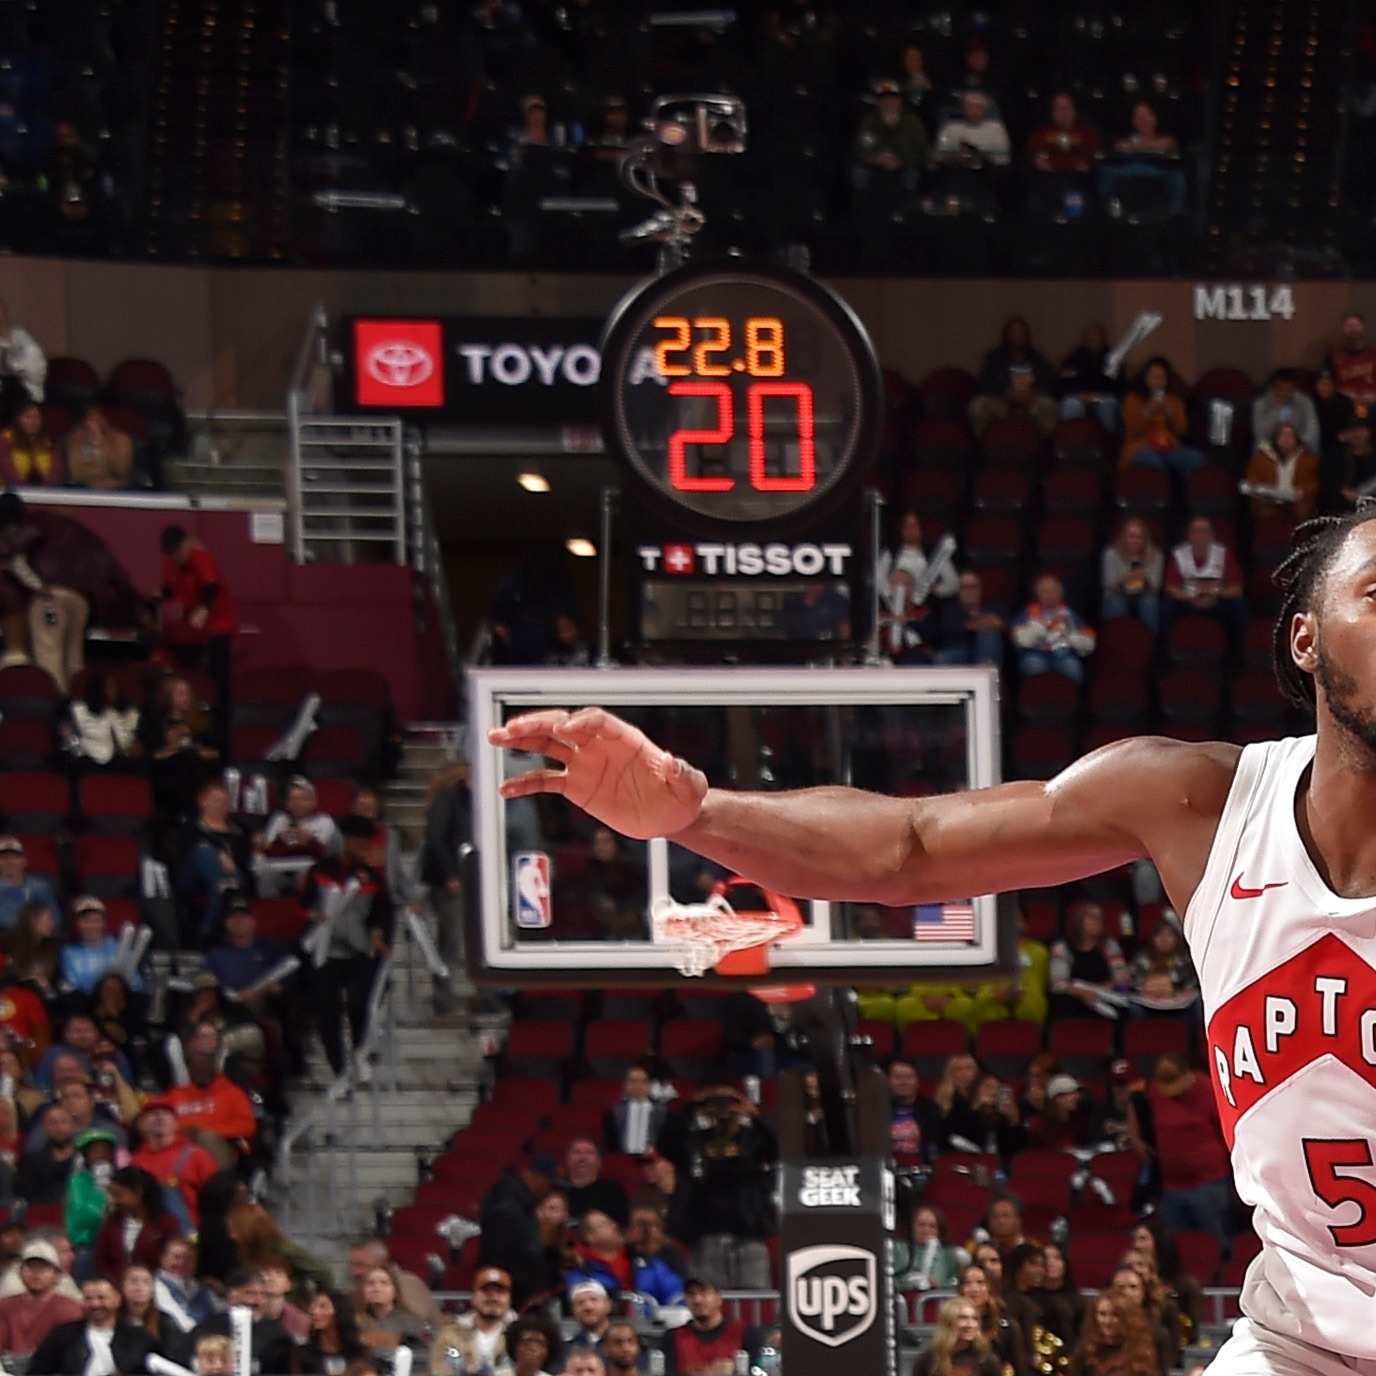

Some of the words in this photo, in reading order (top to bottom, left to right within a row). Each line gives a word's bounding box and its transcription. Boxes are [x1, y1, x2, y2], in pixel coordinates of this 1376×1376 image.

[1193, 284, 1297, 321] M114
[458, 343, 668, 387] TOYOA
[653, 316, 785, 377] 22.8
[667, 382, 816, 491] 20
[696, 543, 852, 575] TISSOT
[803, 1165, 860, 1188] SEAT
[800, 1187, 862, 1207] GEEK
[797, 1274, 870, 1331] ups
